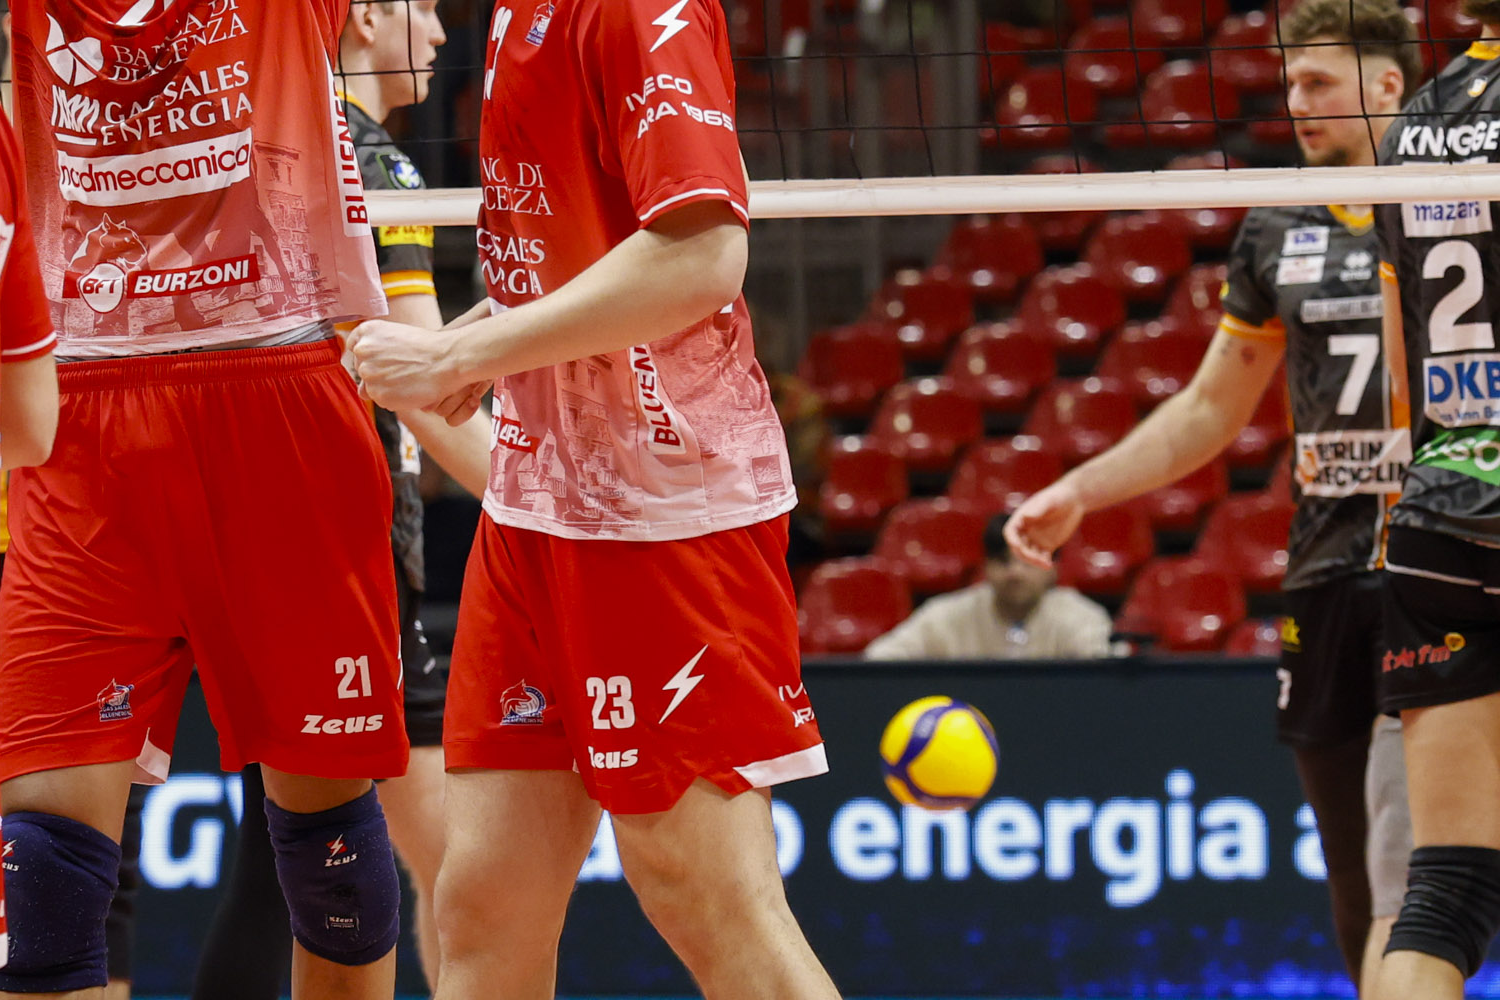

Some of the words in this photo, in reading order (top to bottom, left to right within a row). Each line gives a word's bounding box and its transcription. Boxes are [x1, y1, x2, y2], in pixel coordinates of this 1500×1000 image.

[163, 60, 249, 106] SALES
[625, 74, 692, 112] IVECO
[101, 92, 253, 146] ENERGIA
[637, 101, 678, 139] ARA
[681, 101, 734, 132] 1965
[61, 144, 249, 192] nodmeccanica
[517, 162, 546, 188] DI
[83, 277, 120, 295] BFT
[134, 259, 249, 294] BURZONI
[1422, 239, 1495, 354] 2
[1328, 333, 1380, 416] 7
[334, 656, 372, 699] 21
[301, 714, 383, 735] Zeus
[586, 676, 636, 730] 23
[828, 768, 1268, 908] energia
[2, 862, 19, 871] eus
[324, 853, 358, 867] Zeus
